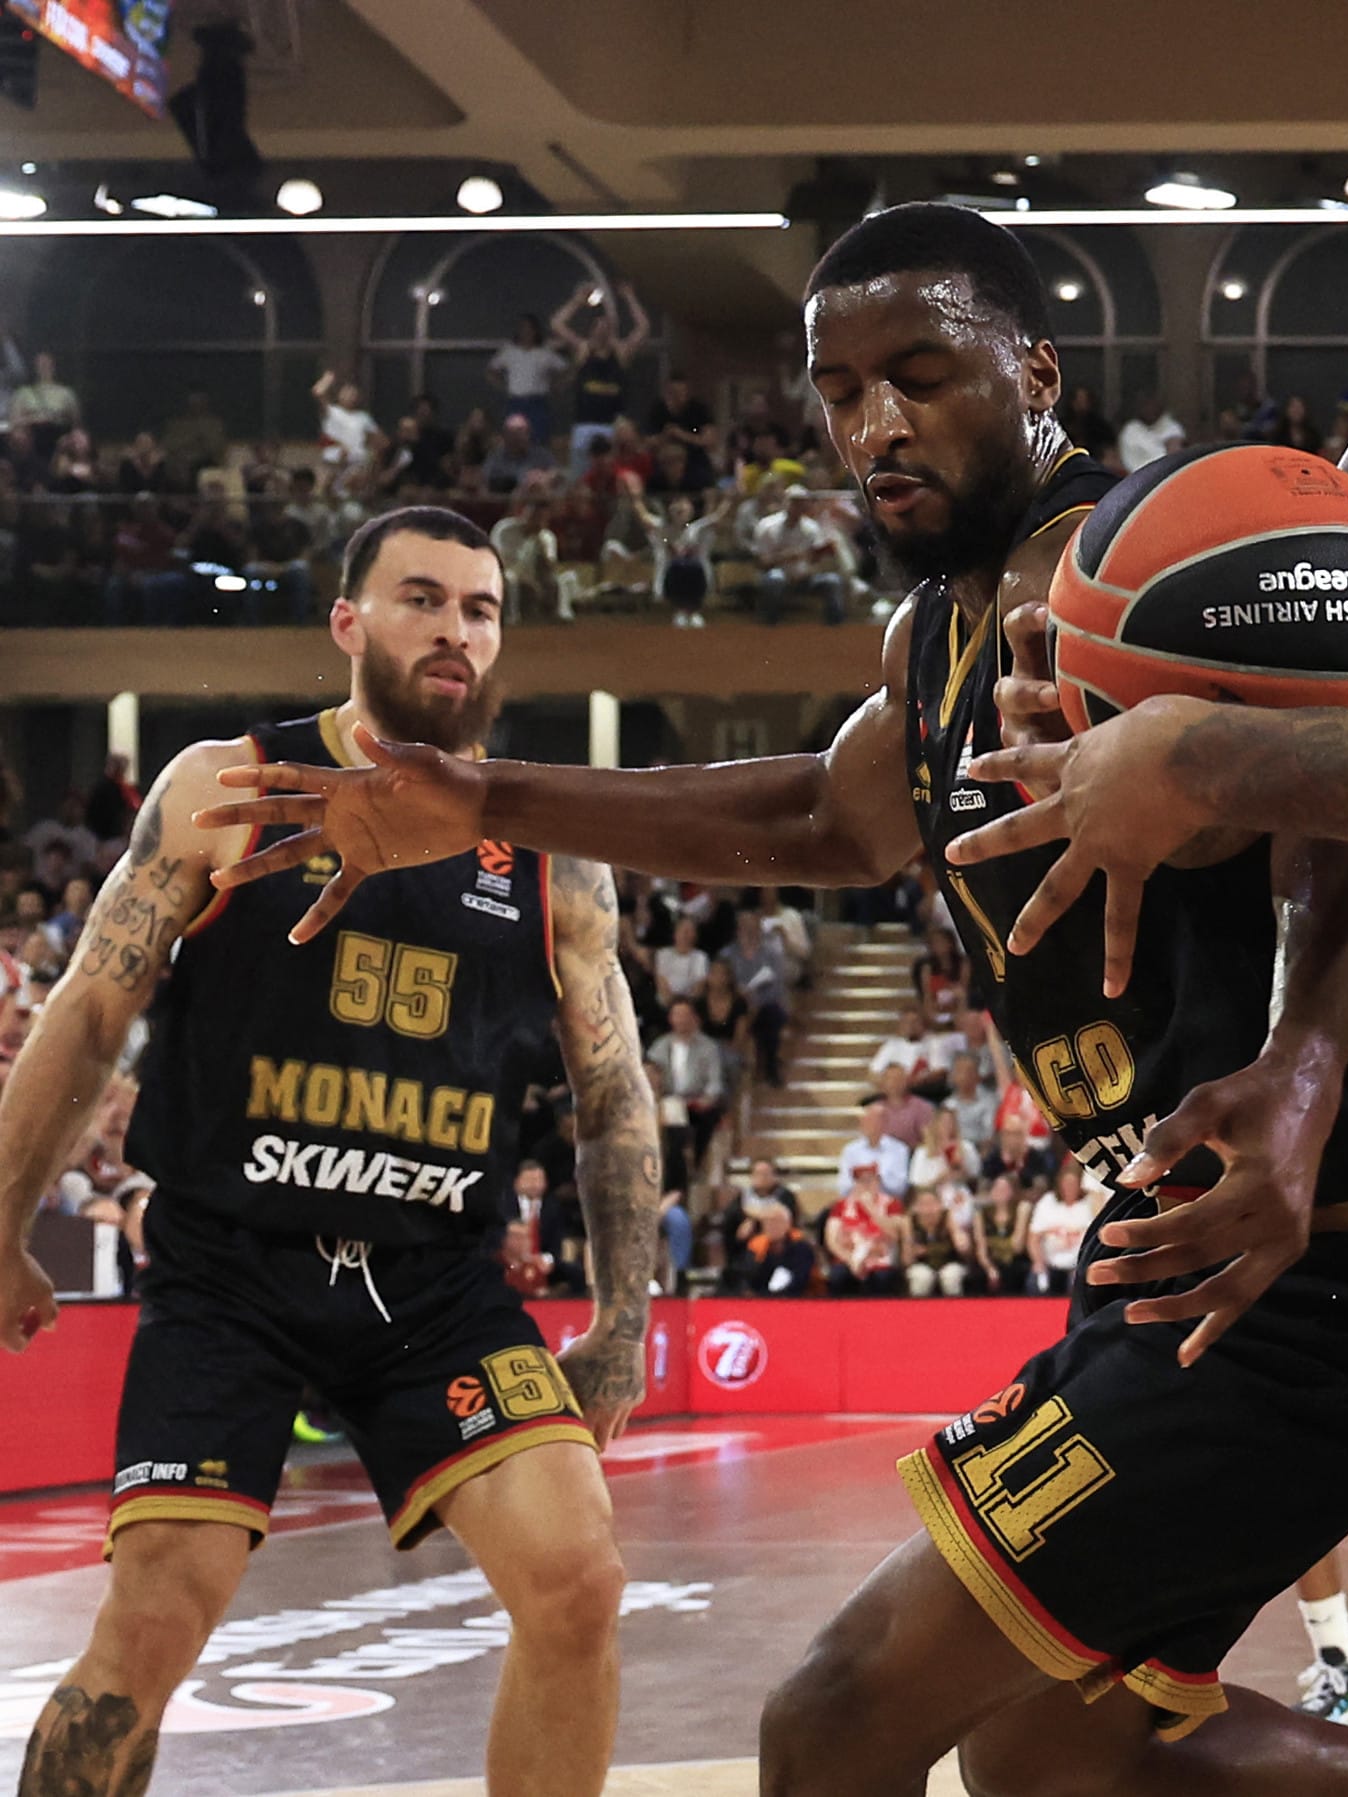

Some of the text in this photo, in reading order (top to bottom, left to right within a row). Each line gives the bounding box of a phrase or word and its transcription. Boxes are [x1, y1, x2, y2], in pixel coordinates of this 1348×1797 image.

[1202, 600, 1319, 628] AIRLINES
[330, 930, 458, 1040] 55
[245, 1055, 496, 1155] MONACO
[243, 1134, 486, 1212] SKWEEK
[151, 1462, 187, 1480] INFO
[951, 1394, 1117, 1563] 11
